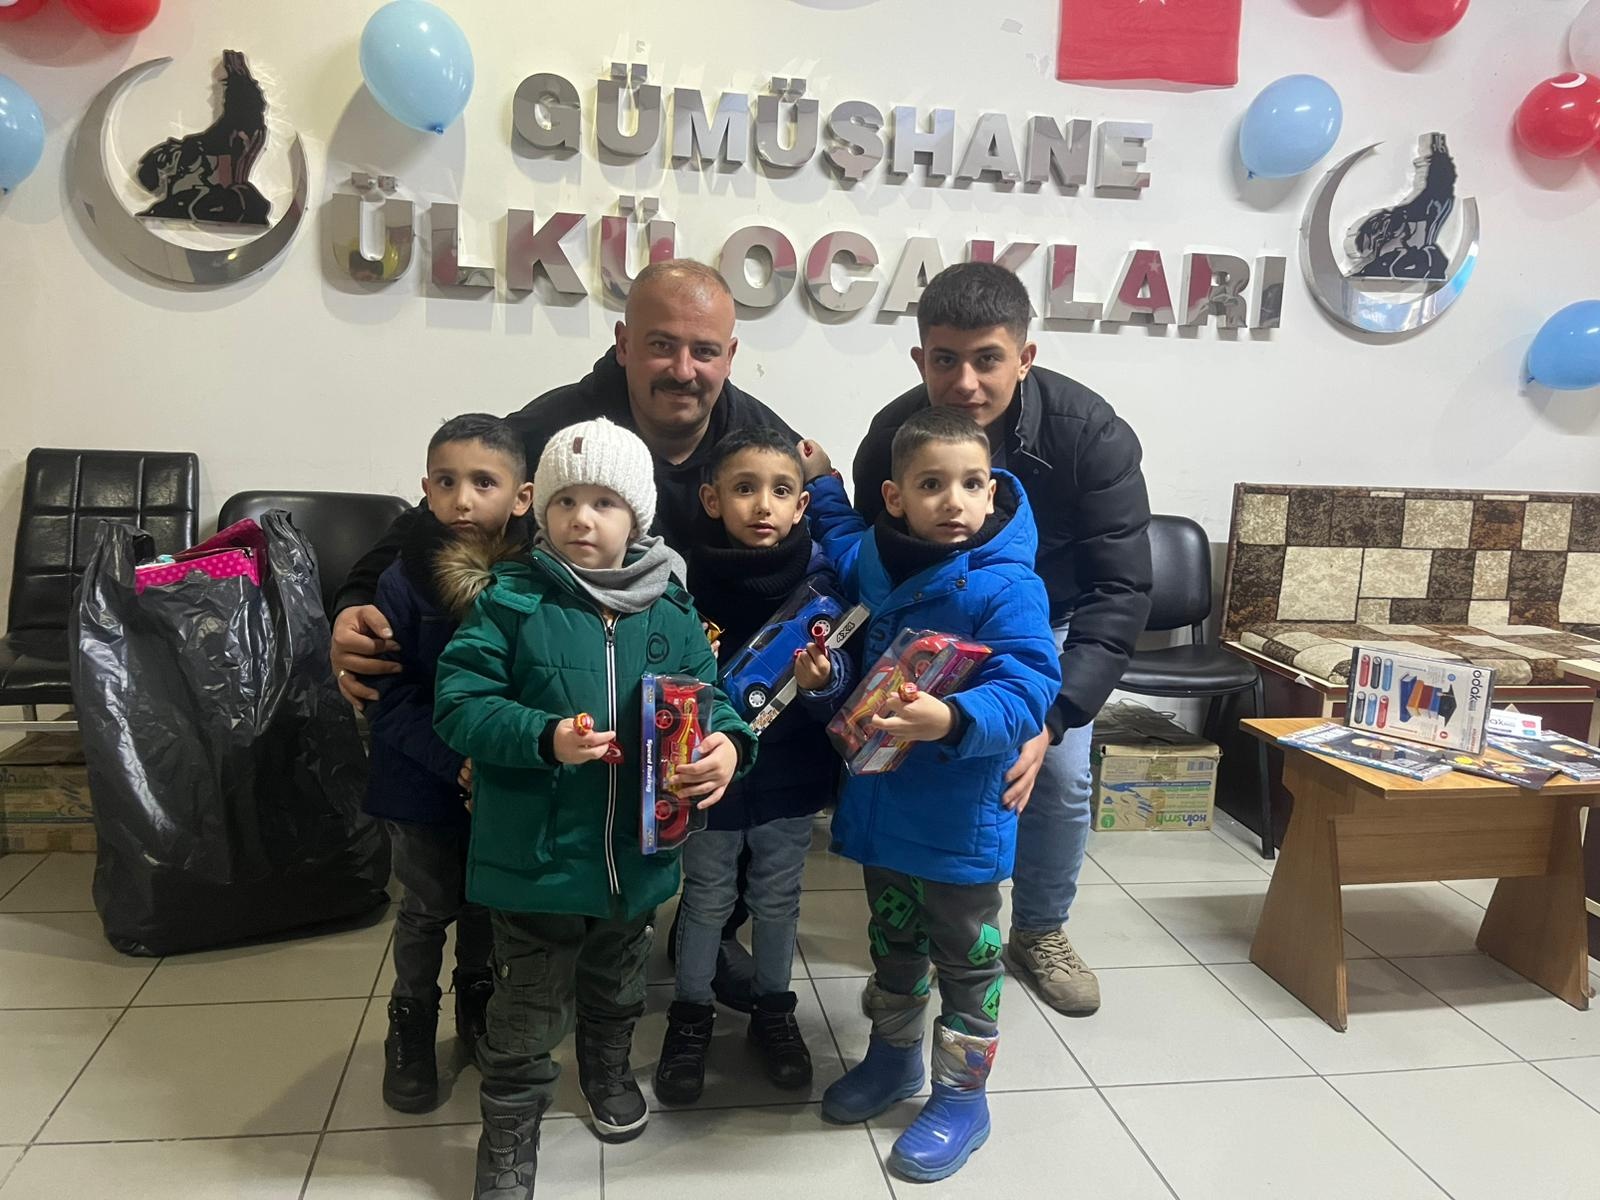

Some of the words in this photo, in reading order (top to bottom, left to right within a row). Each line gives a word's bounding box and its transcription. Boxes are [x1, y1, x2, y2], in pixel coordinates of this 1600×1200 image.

[512, 62, 1154, 194] GÜMÜŞHANE
[331, 171, 677, 301] ÜLKÜ
[645, 764, 653, 793] Racing
[646, 738, 654, 764] Speed
